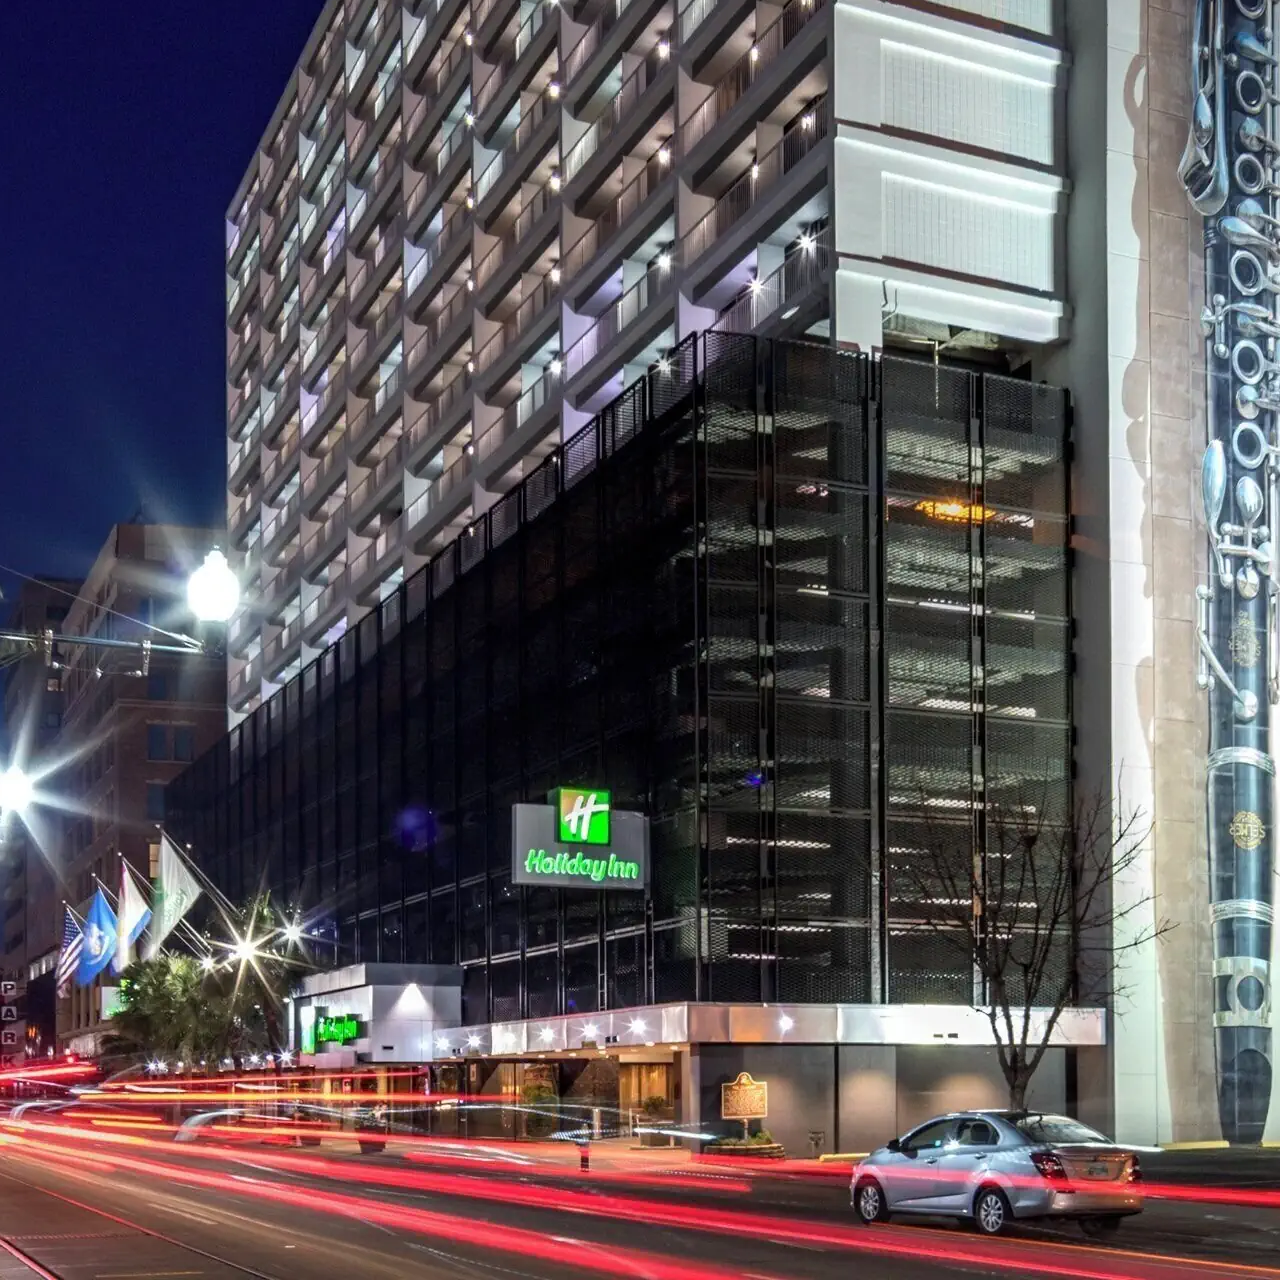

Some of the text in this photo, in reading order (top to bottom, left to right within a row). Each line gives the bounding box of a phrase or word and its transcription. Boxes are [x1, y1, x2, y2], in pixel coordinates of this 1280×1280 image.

[1229, 823, 1266, 838] SELMER
[524, 848, 639, 882] Holiday Inn
